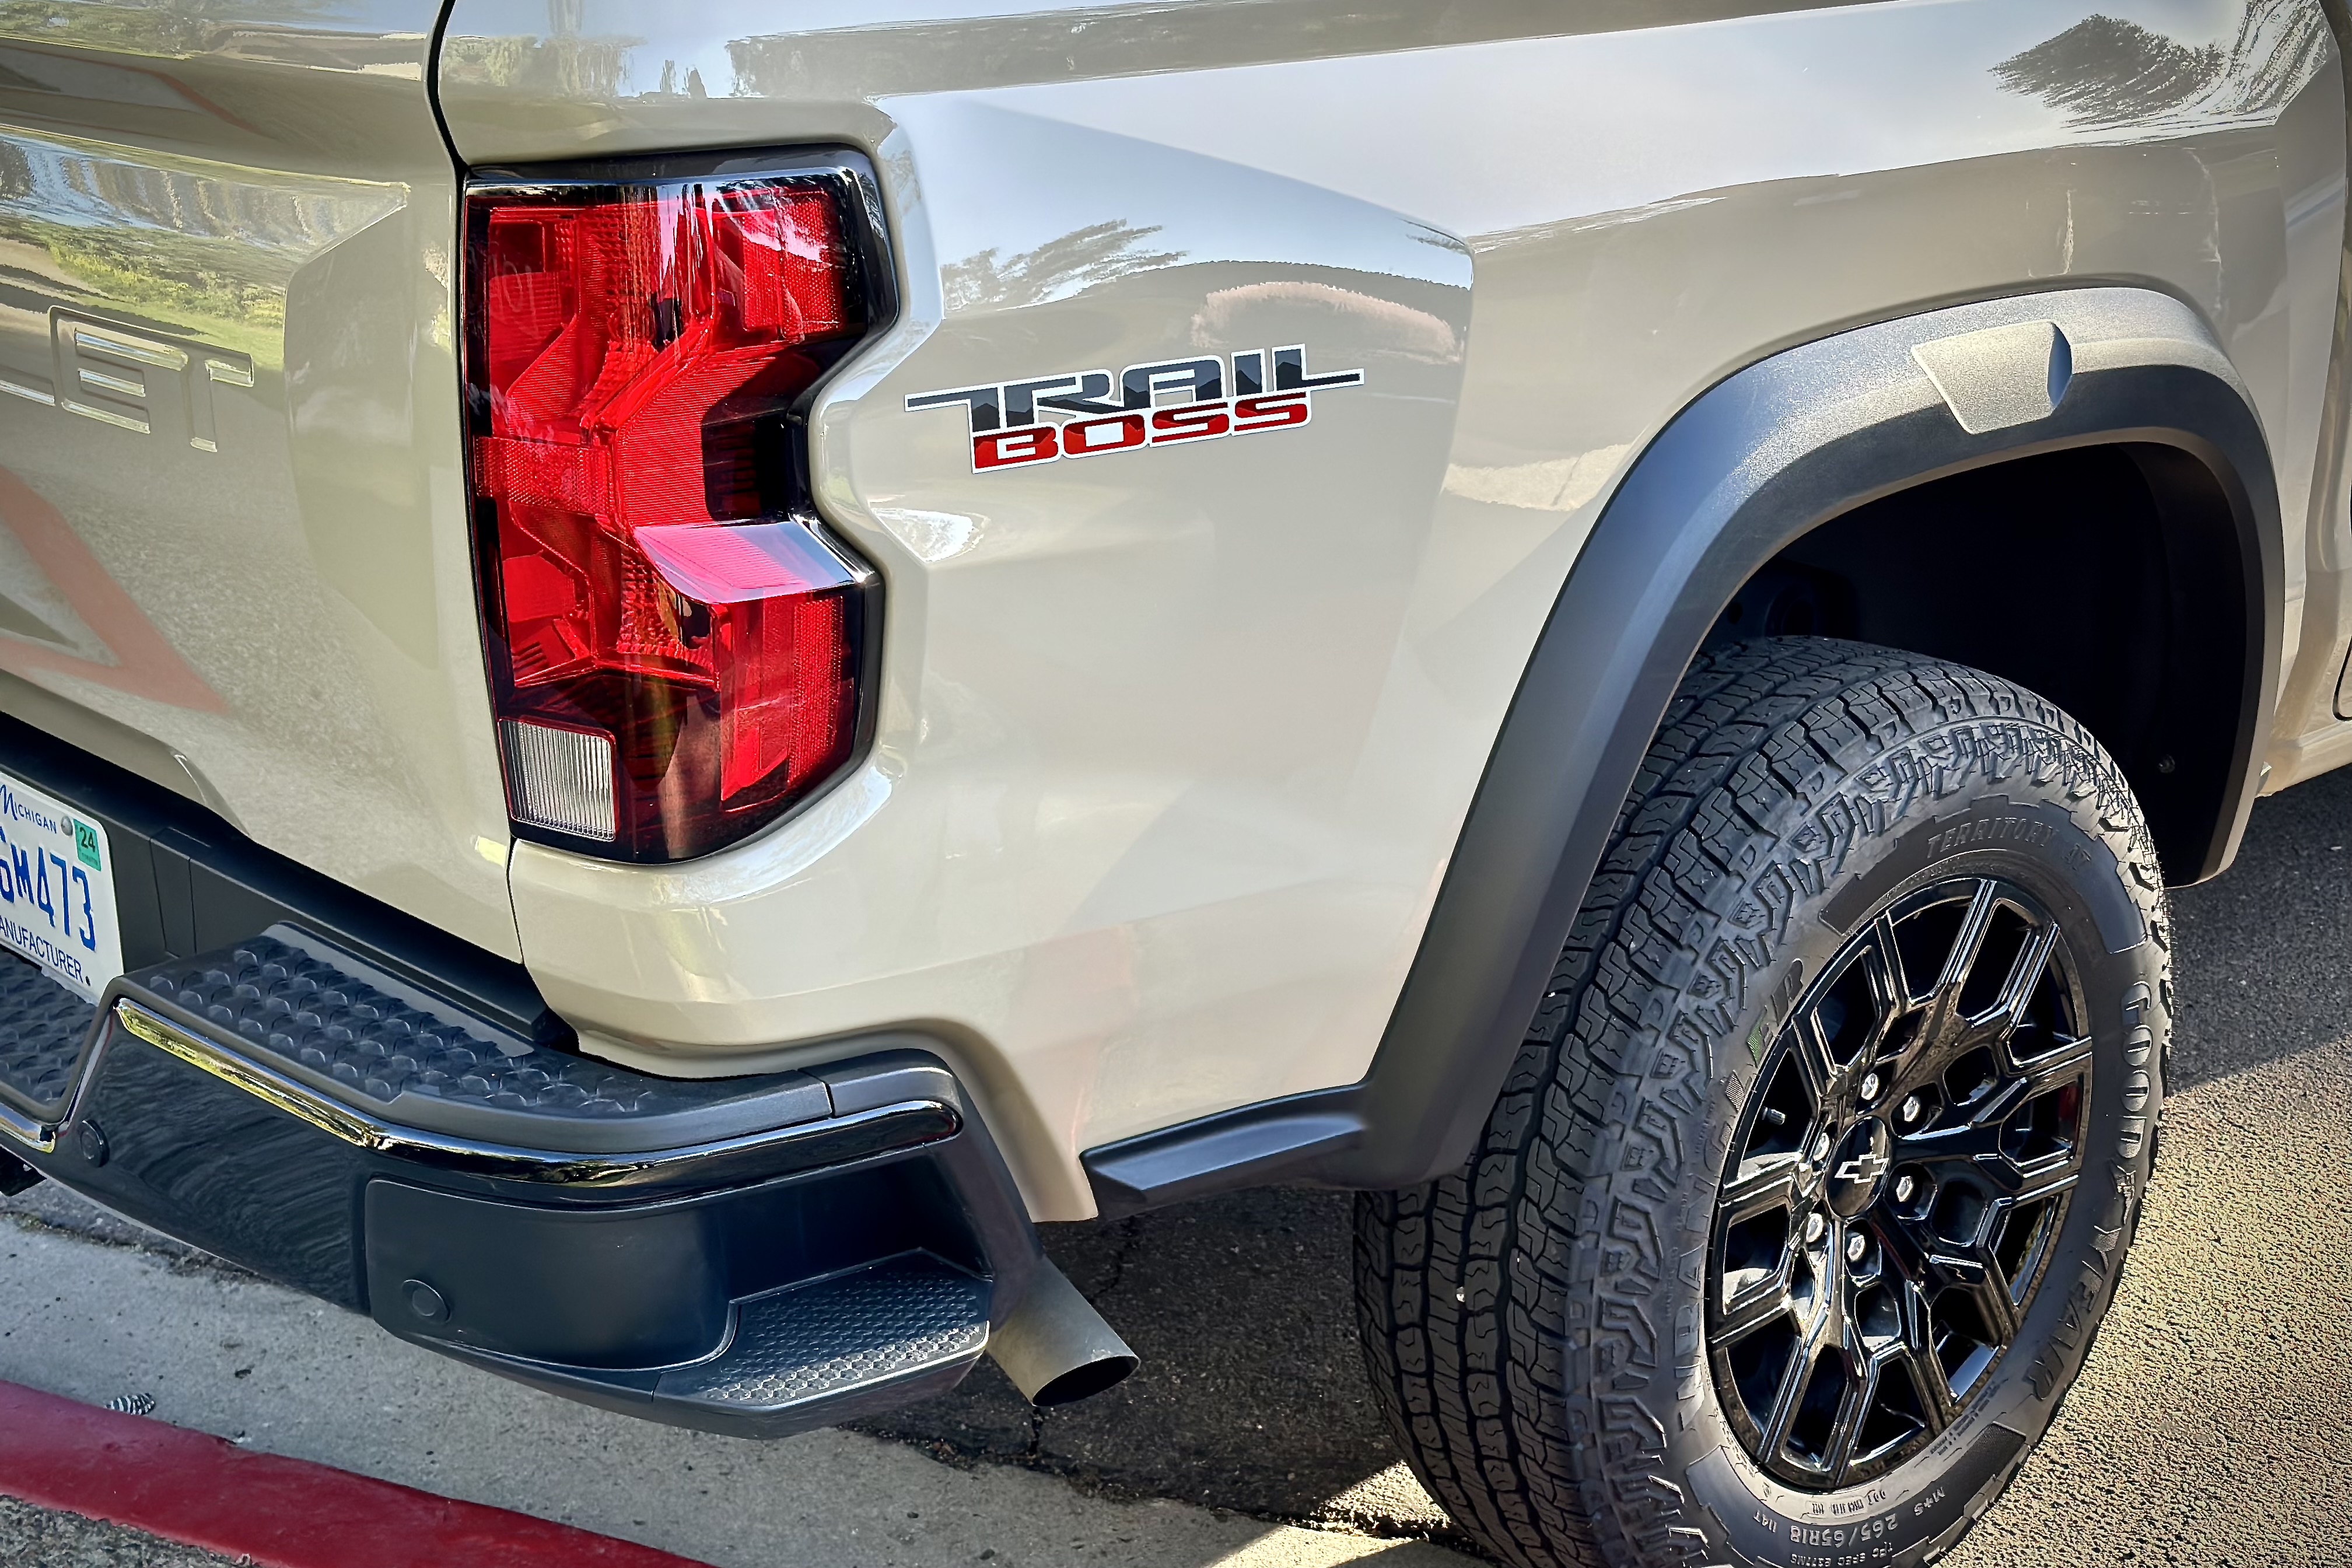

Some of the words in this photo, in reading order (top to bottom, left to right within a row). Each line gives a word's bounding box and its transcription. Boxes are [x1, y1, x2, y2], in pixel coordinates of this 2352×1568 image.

[905, 345, 1364, 432] TRAIL
[972, 391, 1311, 473] BOSS
[0, 785, 57, 834] MICHIGAN
[79, 827, 96, 852] 24
[1927, 818, 2058, 858] TERRITORY
[1790, 1513, 1898, 1548] 265/65R18
